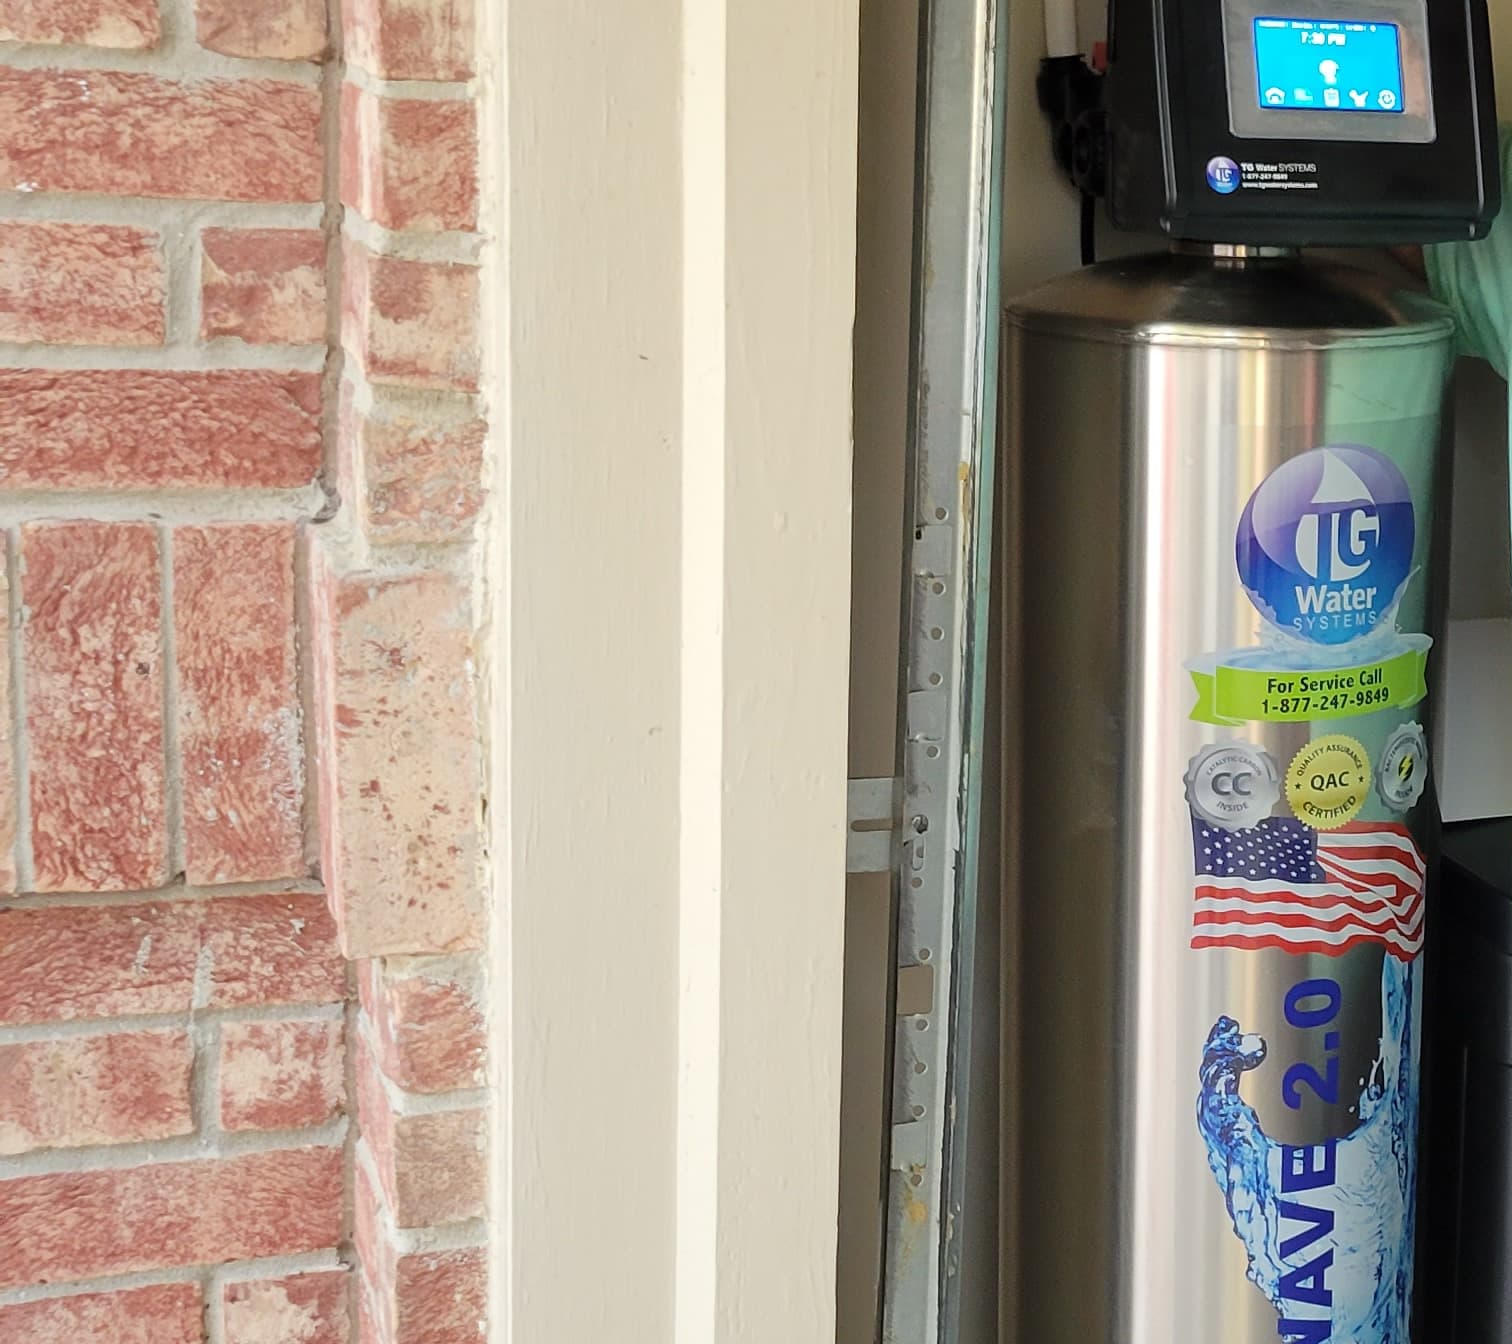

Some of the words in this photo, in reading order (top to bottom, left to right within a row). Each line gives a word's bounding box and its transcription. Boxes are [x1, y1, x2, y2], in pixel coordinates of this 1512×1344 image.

[1255, 163, 1278, 172] Water
[1279, 163, 1317, 173] SYSTEMS
[1295, 584, 1377, 615] Water
[1292, 610, 1377, 632] SYSTEMS
[1267, 678, 1294, 694] For
[1299, 674, 1355, 693] Service
[1359, 668, 1383, 685] Call
[1262, 687, 1390, 714] 1-877-247-9849
[1206, 756, 1237, 776] CATALYTIC
[1296, 746, 1325, 777] QUALITY
[1326, 744, 1363, 770] ASSURANCE
[1211, 772, 1252, 796] CC
[1310, 771, 1350, 792] QAC
[1216, 800, 1249, 812] INSIDE
[1302, 795, 1357, 819] CERTIFIED
[1282, 978, 1342, 1111] 2.0
